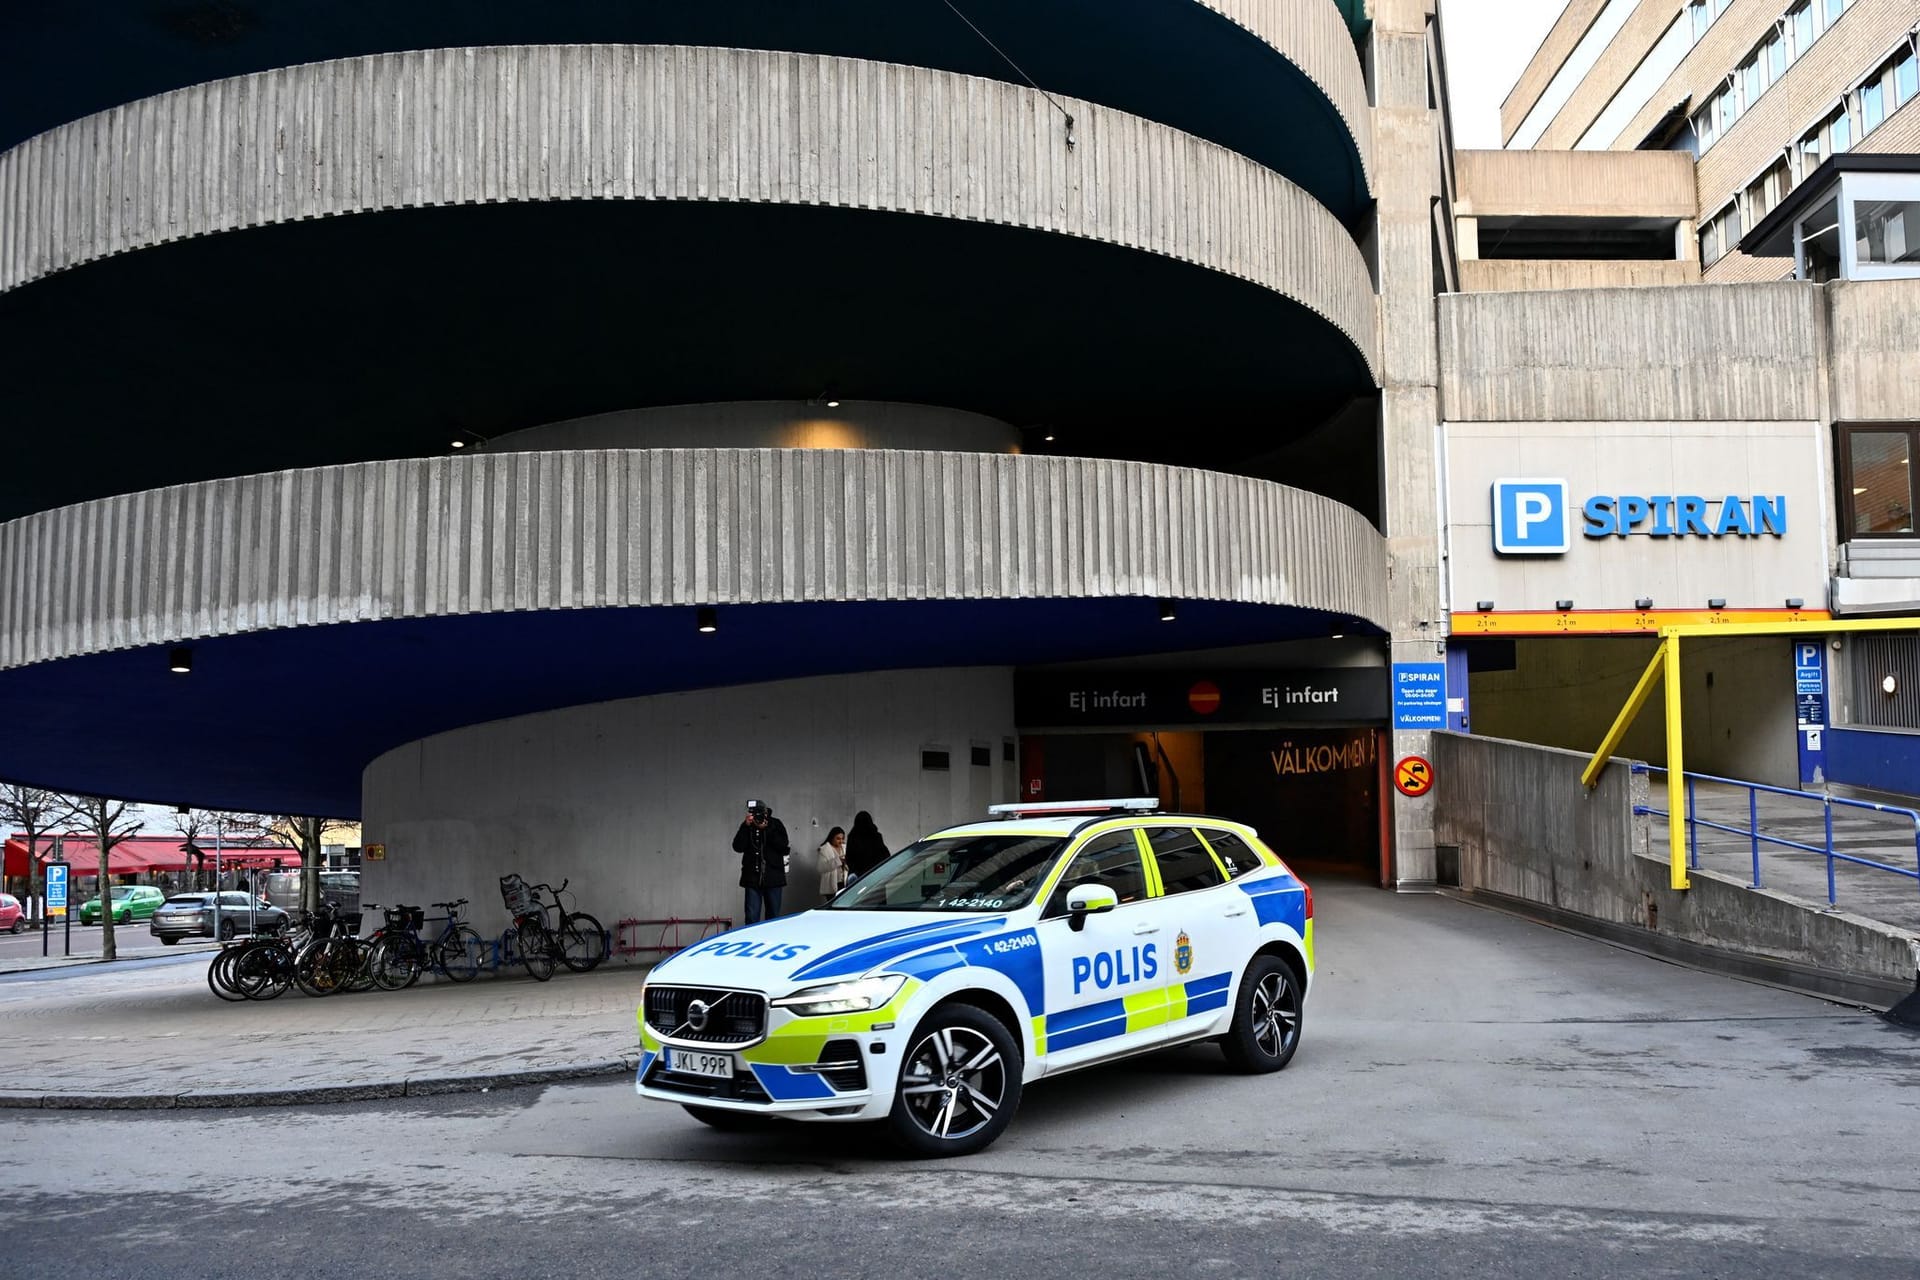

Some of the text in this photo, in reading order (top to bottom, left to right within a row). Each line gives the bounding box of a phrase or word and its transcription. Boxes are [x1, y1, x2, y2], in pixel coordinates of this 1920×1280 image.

[1515, 492, 1788, 539] P SPIRAN
[1803, 646, 1816, 665] P
[1408, 673, 1440, 681] SPIRAN
[1070, 691, 1147, 712] Ej infart
[1262, 686, 1339, 708] Ej infart
[1271, 737, 1365, 775] VÄLKOMMEN
[53, 868, 63, 881] P
[948, 898, 1003, 908] 42-2140
[688, 942, 811, 961] POLIS
[983, 934, 1037, 955] 1 42-2140
[1072, 943, 1158, 994] POLIS
[674, 1051, 727, 1076] JKL 99R
